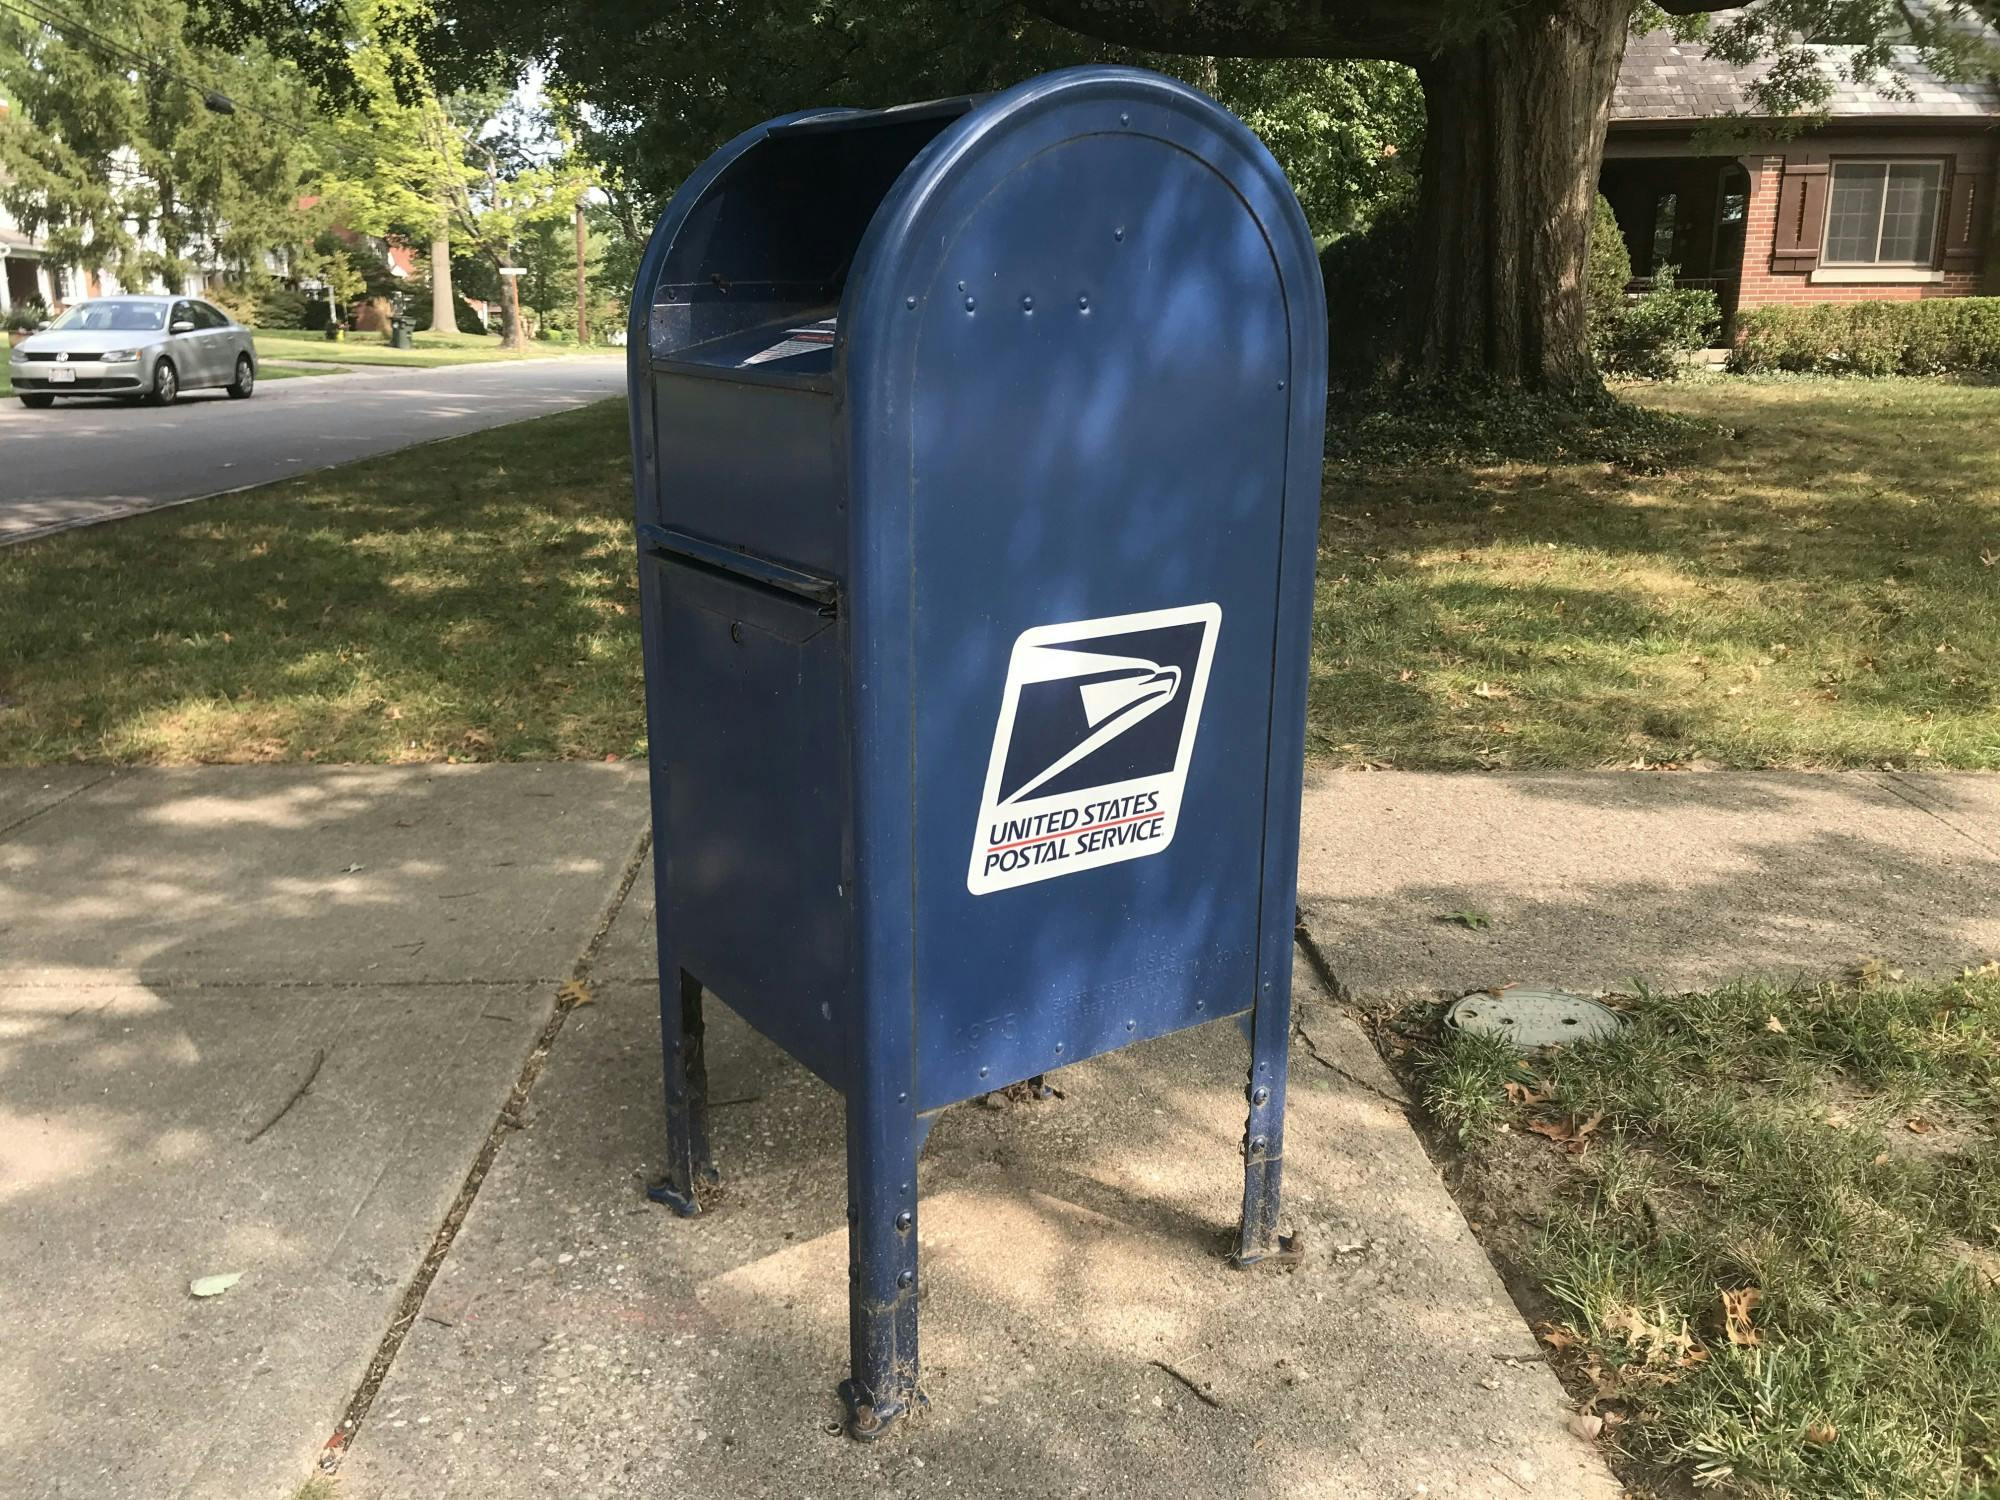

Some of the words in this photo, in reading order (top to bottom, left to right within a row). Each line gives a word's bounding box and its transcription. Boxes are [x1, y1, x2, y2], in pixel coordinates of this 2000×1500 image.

[990, 808, 1079, 845] UNITED
[1082, 791, 1160, 826] STATES
[984, 838, 1070, 877] POSTAL
[1075, 817, 1165, 856] SERVICE
